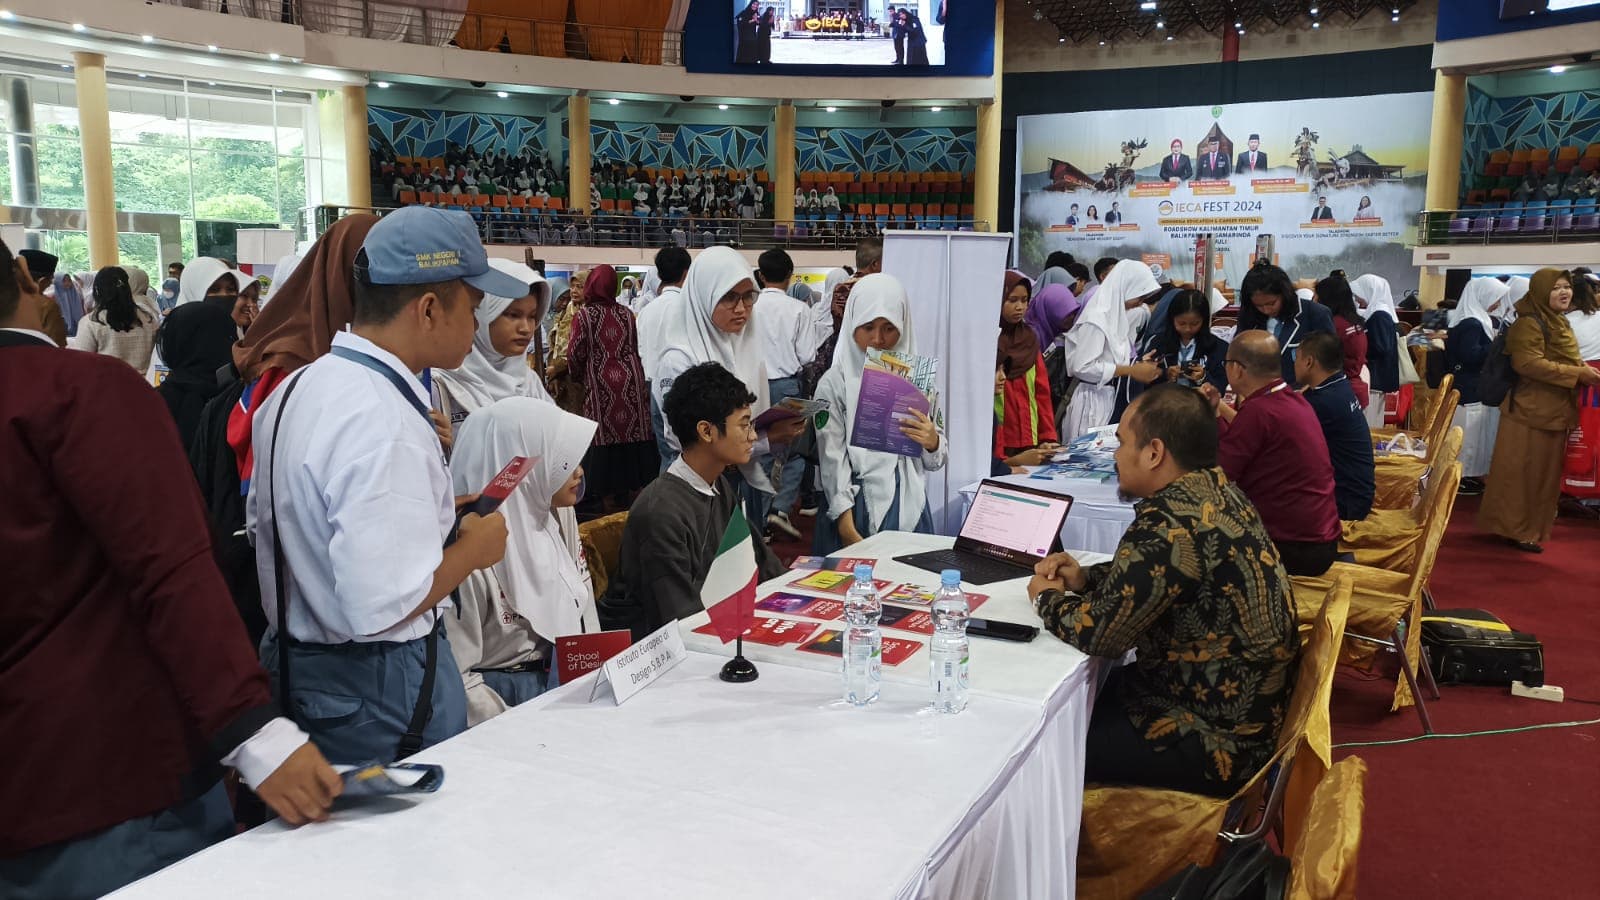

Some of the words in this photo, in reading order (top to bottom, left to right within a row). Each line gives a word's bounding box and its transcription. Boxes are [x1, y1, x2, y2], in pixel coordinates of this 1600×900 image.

[822, 17, 849, 28] IECA
[1233, 200, 1263, 212] 2024
[415, 253, 432, 262] SMK
[433, 251, 456, 259] NEGERI
[418, 257, 460, 269] BALIKPAPAN
[640, 634, 663, 655] Europeo
[567, 651, 600, 662] School
[568, 662, 578, 671] of
[580, 660, 601, 670] Desi
[630, 664, 652, 685] Design
